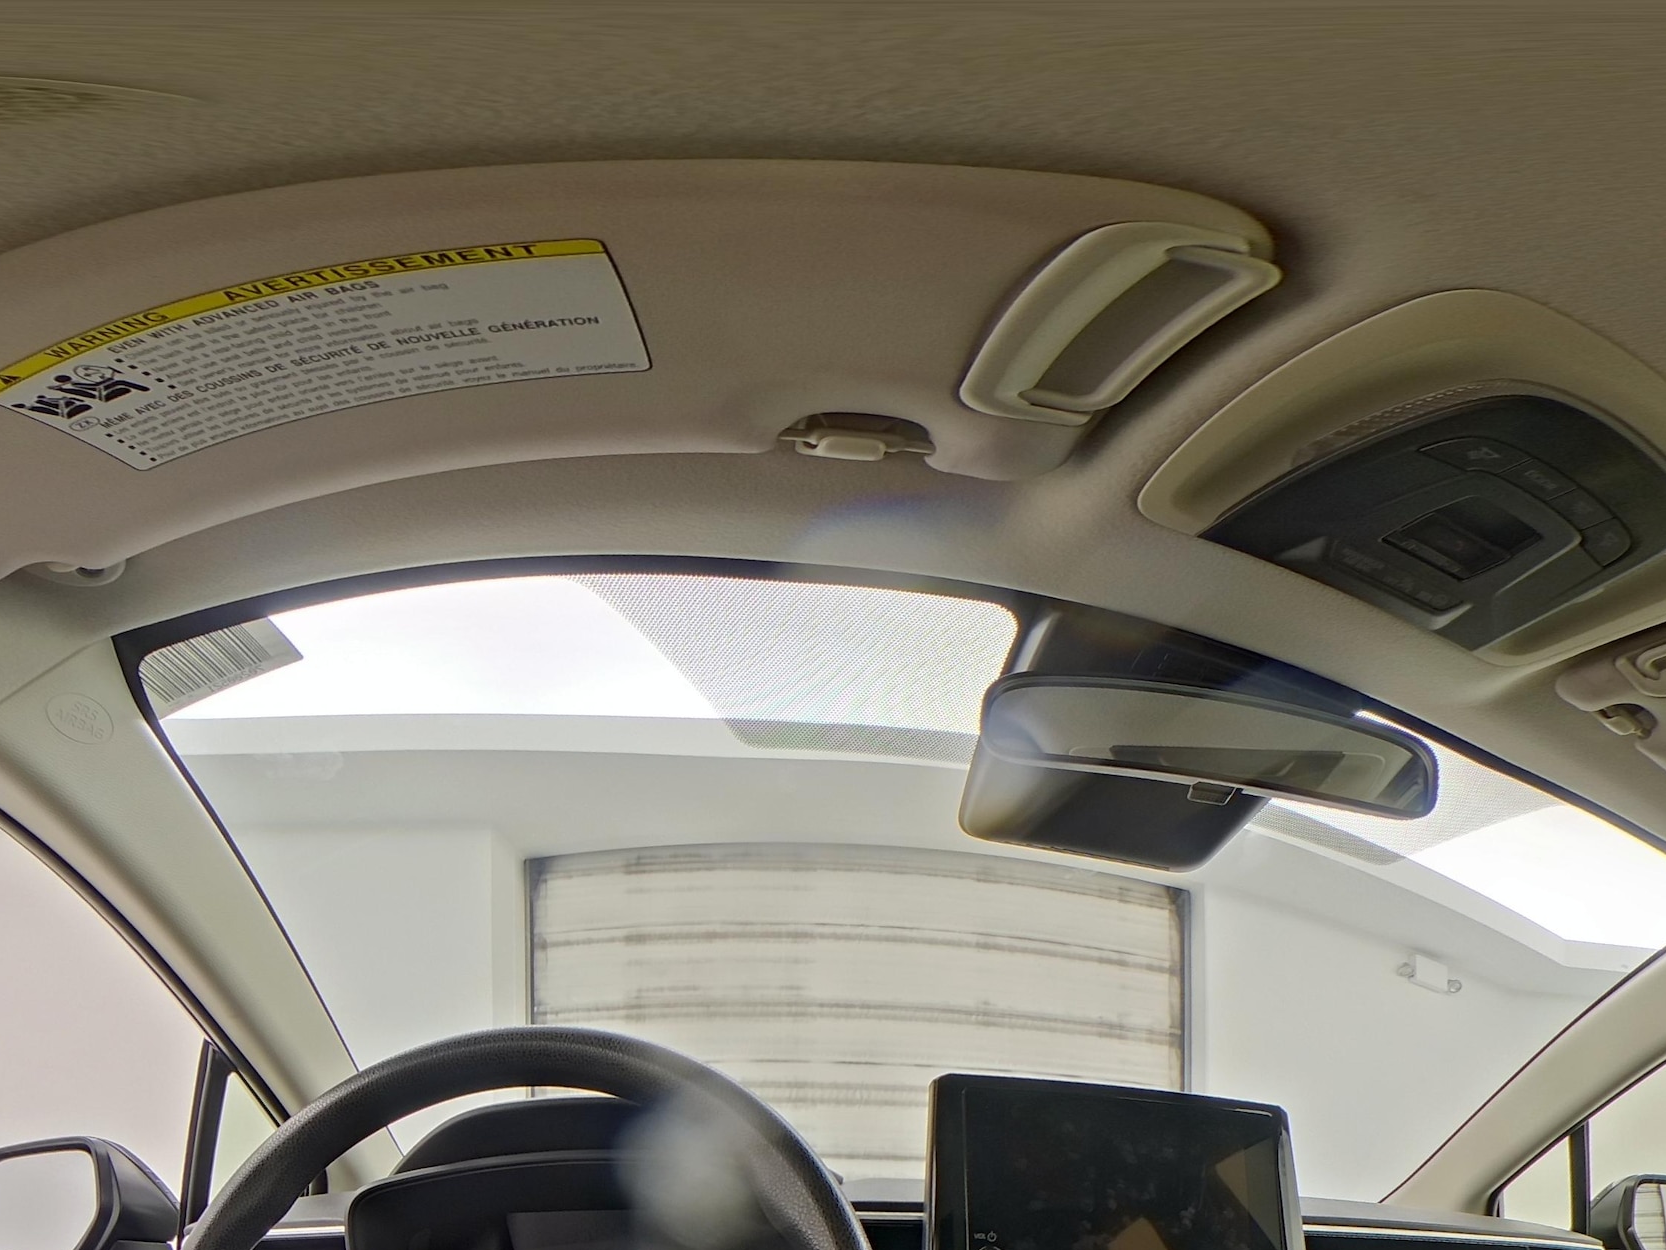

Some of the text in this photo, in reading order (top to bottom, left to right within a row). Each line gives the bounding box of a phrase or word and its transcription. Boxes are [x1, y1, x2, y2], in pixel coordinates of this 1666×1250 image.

[224, 244, 537, 302] AVERTISSEMENT
[44, 311, 171, 360] WARNING
[107, 337, 147, 354] EVEN
[147, 324, 189, 339] WITH
[192, 300, 279, 326] ADVANCED
[287, 291, 319, 303] AIR
[324, 280, 380, 295] BAGS
[134, 400, 166, 415] AVEC
[167, 390, 194, 402] DES
[195, 369, 263, 393] COUSSINS
[264, 362, 288, 373] DE
[290, 344, 363, 367] SÉCURITÉ
[367, 340, 391, 350] DE
[396, 327, 481, 346] NOUVELLE
[488, 316, 600, 333] GÉNÉRATION
